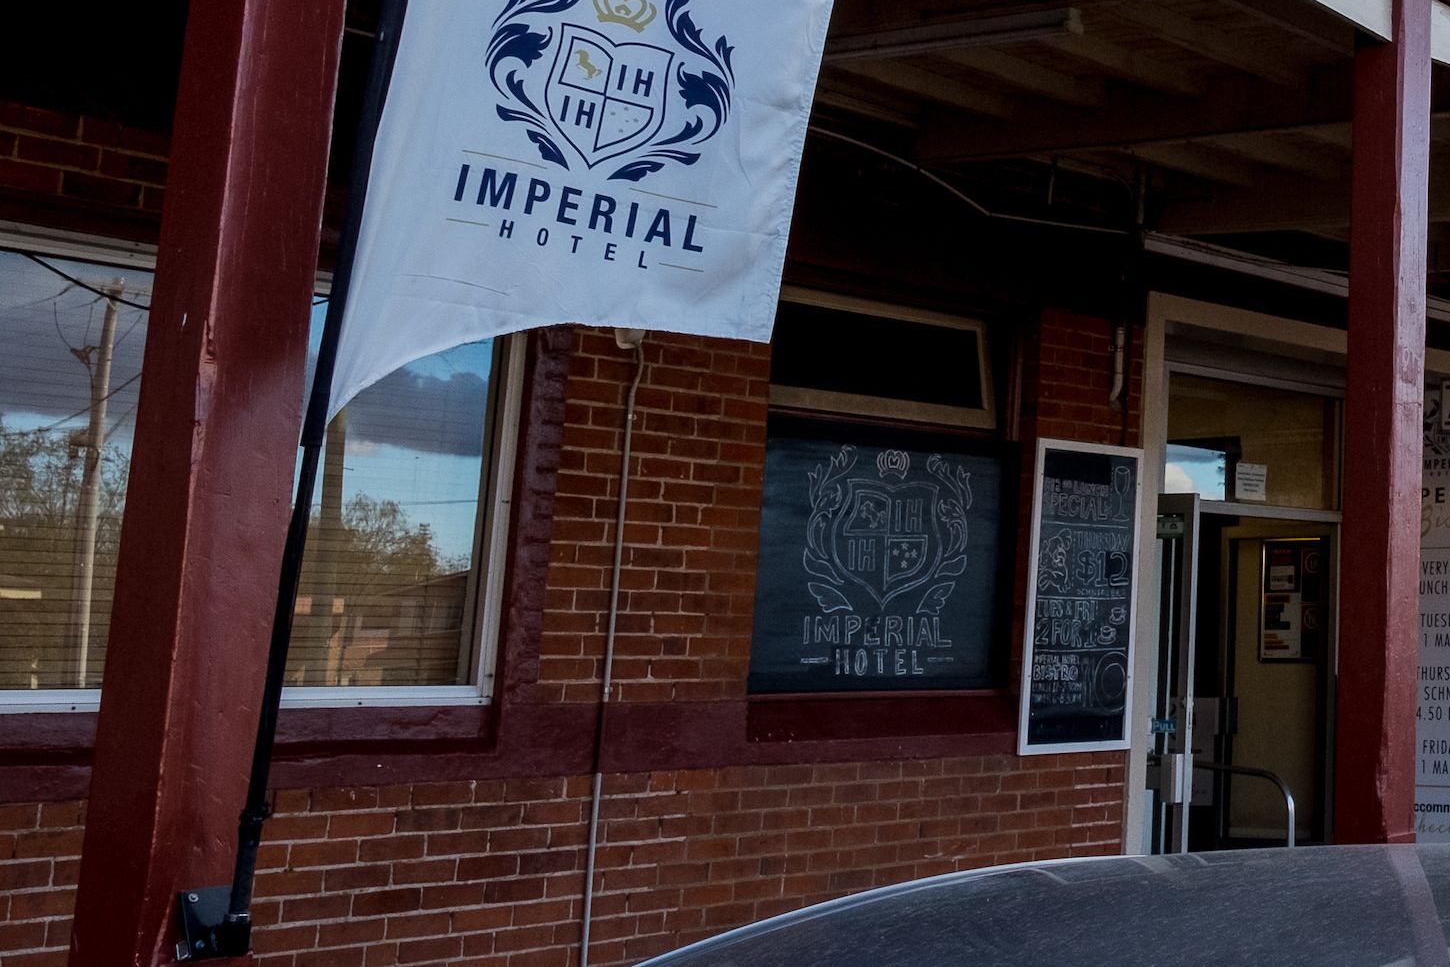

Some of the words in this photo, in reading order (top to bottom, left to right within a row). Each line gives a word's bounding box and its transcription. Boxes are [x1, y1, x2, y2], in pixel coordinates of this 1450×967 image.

[617, 64, 654, 97] IH
[560, 95, 596, 129] IH
[454, 164, 704, 252] IMPERIAL
[499, 220, 647, 269] HOTEL
[895, 499, 923, 533] IH
[850, 539, 876, 571] IH
[1076, 549, 1129, 587] $12
[1421, 561, 1448, 574] VERY
[1420, 580, 1448, 594] UNCH
[1037, 599, 1064, 617] TUES
[803, 616, 951, 647] IMPERIAL
[1035, 618, 1049, 645] 2
[1052, 618, 1082, 647] FOR
[1084, 621, 1096, 648] 1
[834, 649, 924, 675] HOTEL
[1033, 664, 1079, 681] BISTRO
